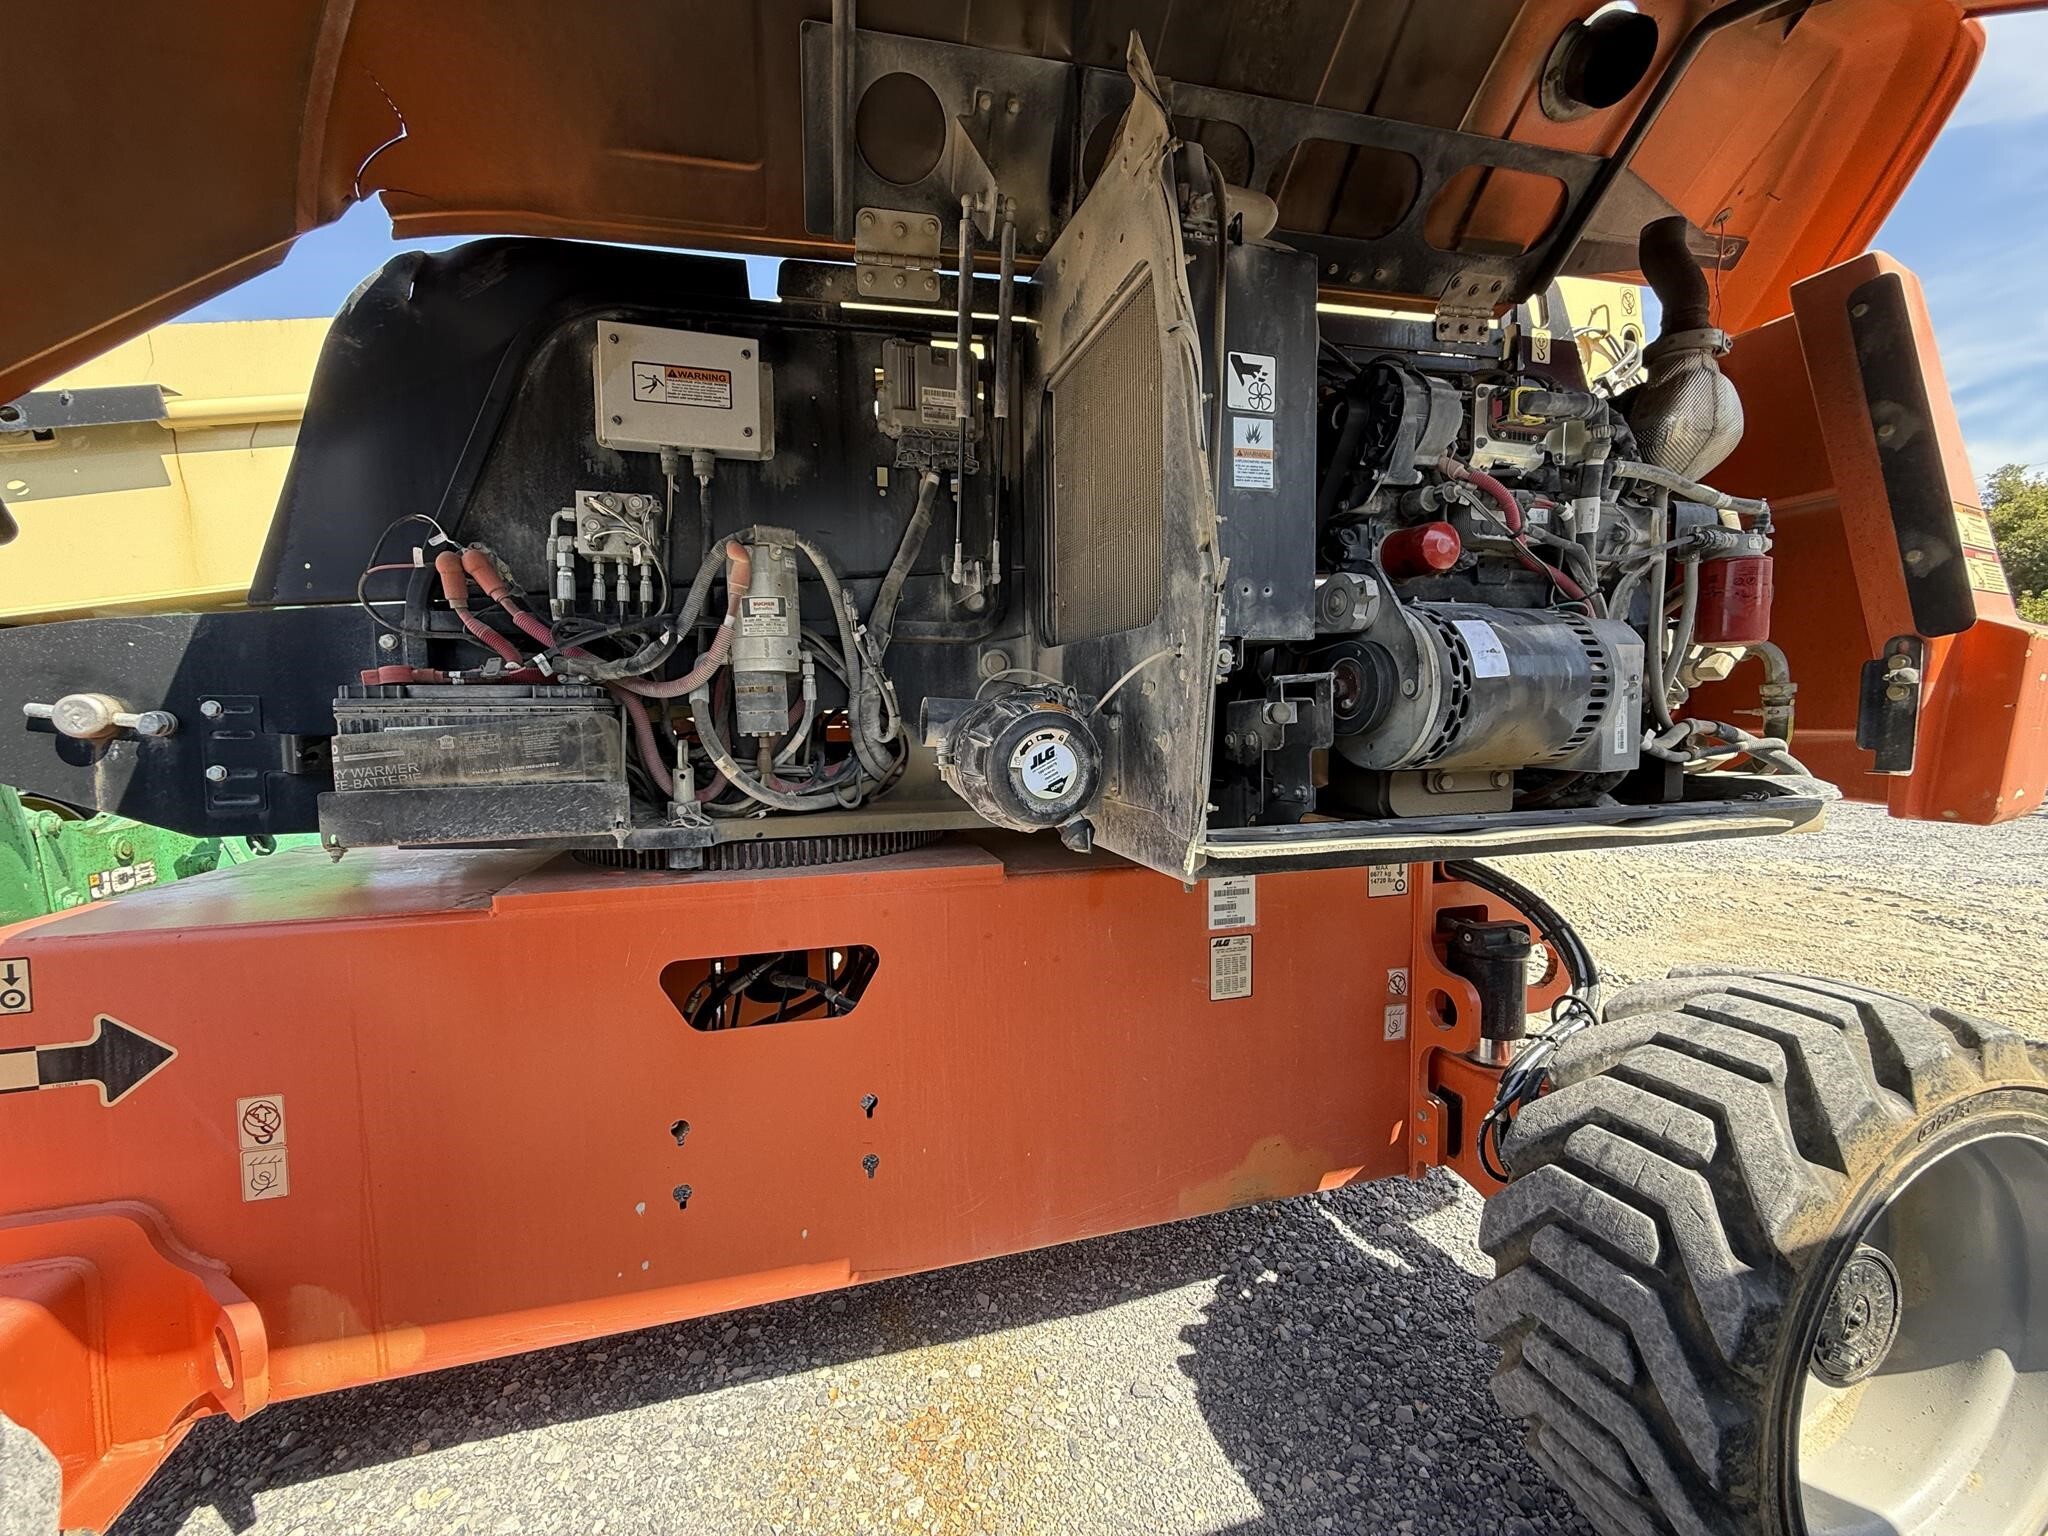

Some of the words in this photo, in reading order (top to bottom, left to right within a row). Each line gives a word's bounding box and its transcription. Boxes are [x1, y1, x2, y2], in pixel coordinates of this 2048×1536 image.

[677, 370, 727, 382] WARNING
[1030, 745, 1055, 770] JLG
[350, 762, 419, 778] WARMER
[89, 860, 157, 899] JCB
[1213, 939, 1230, 948] JLG
